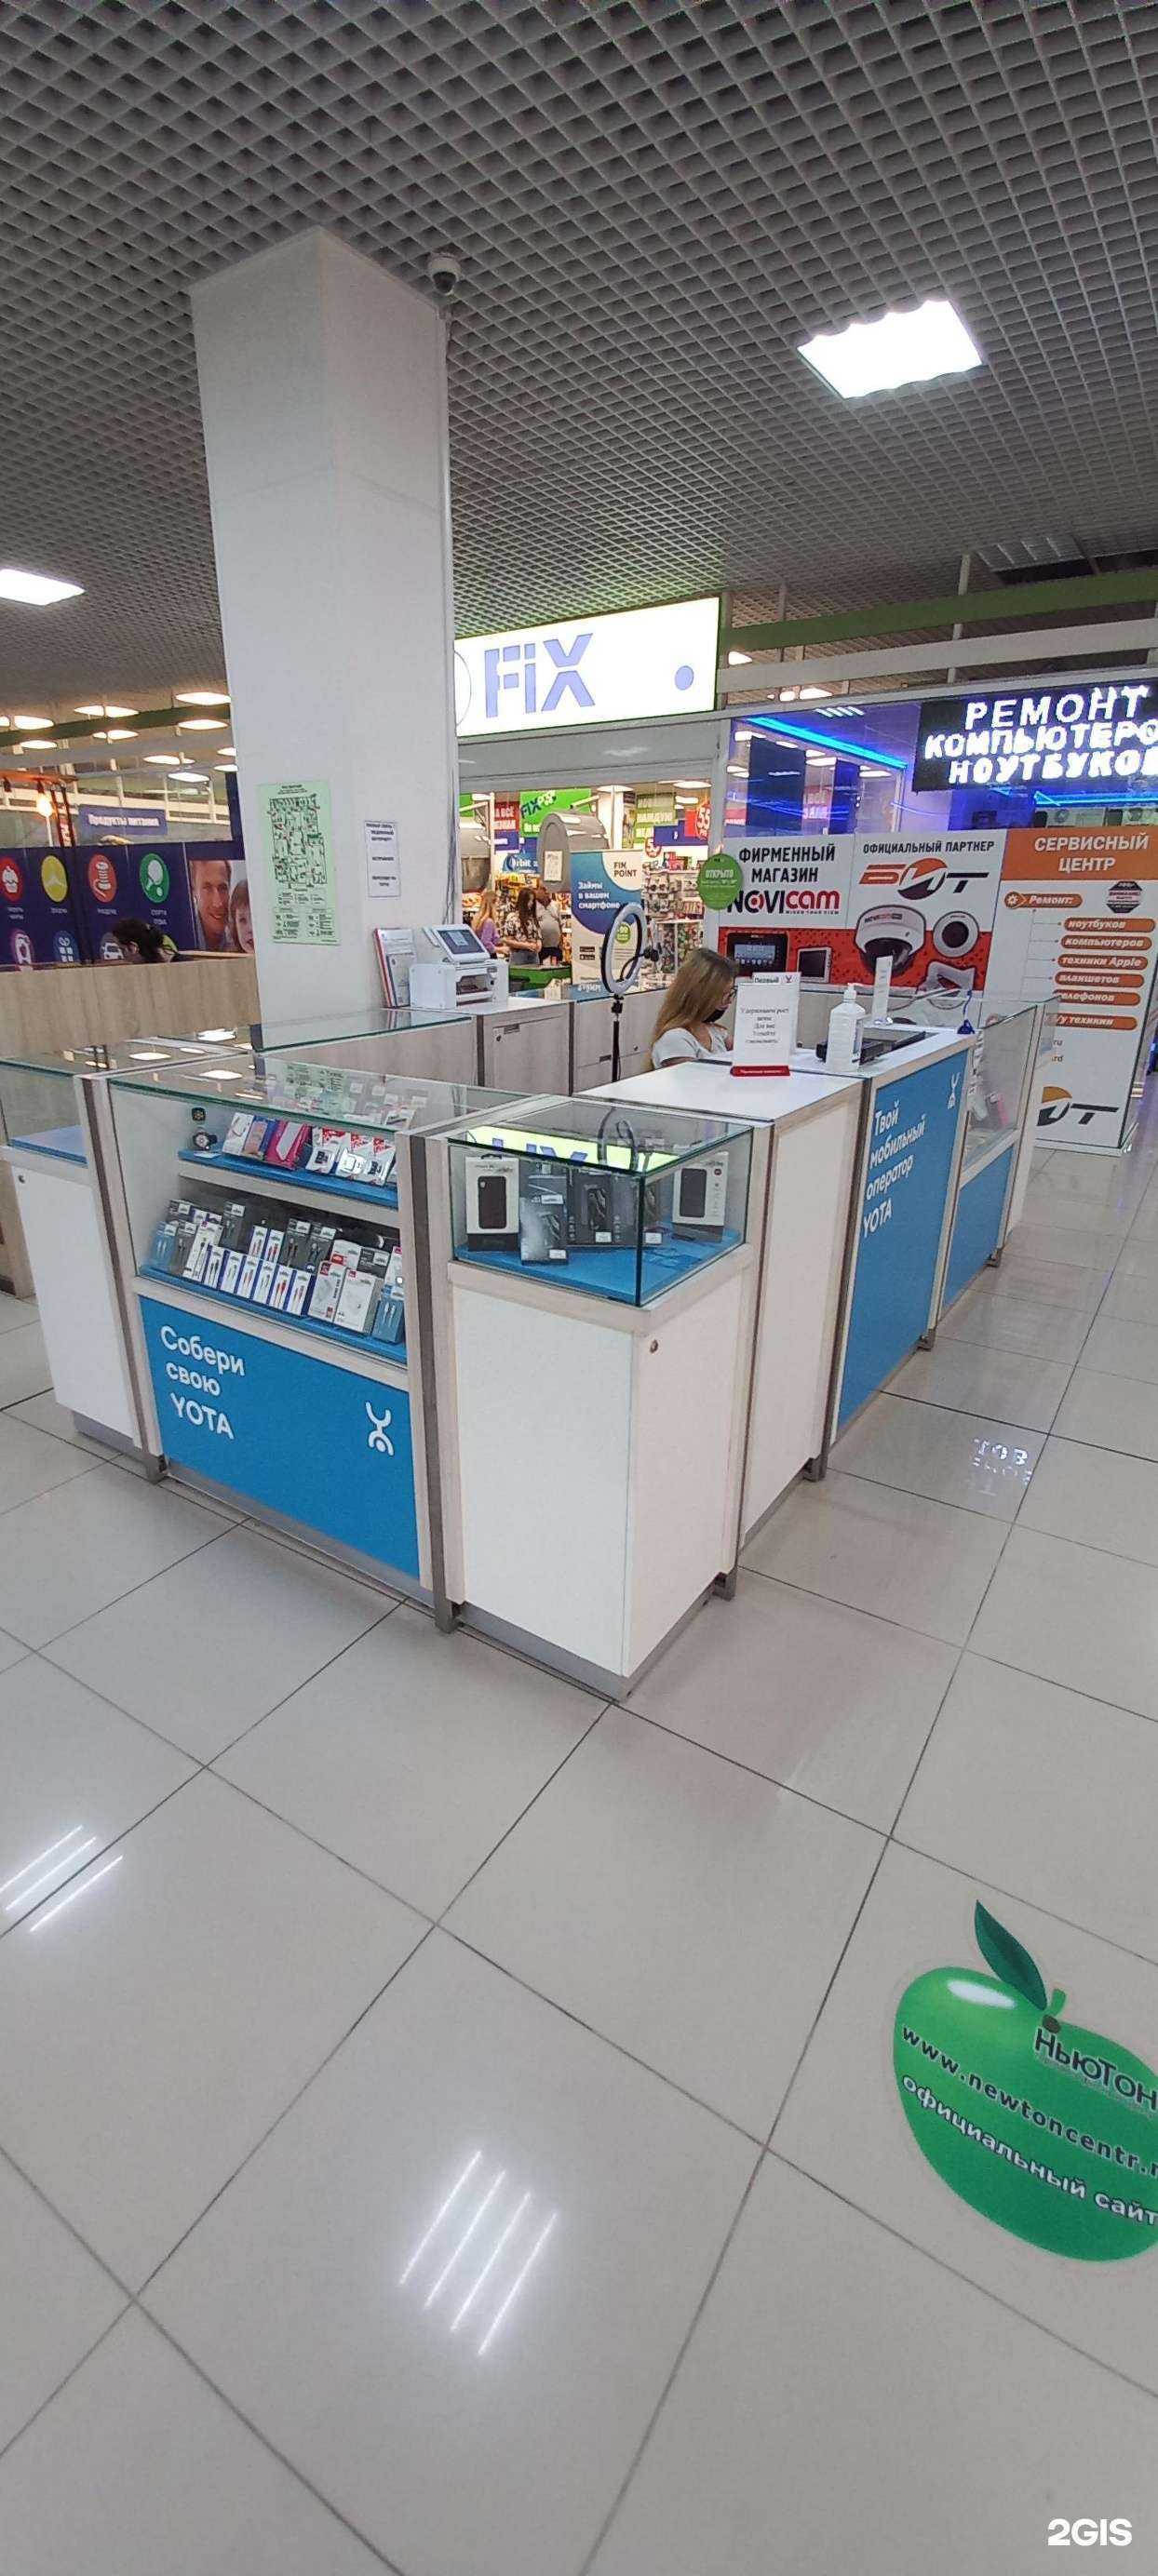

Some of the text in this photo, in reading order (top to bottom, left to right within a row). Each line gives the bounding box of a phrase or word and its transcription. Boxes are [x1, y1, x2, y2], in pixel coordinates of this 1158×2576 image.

[965, 685, 1150, 730] РЕМОНТ
[863, 840, 994, 854] ОФИЦИАЛЬНЫЙ ПАРТНЕР
[1034, 832, 1151, 852] СЕРВИСНЫЙ
[739, 843, 835, 864] ФИРМЕННЫЙ
[613, 870, 638, 879] POINT
[751, 867, 818, 882] МАГАЗИН
[1058, 857, 1116, 874] ЦЕНТР
[578, 881, 603, 891] Займы
[578, 901, 621, 911] смартфоне
[1068, 919, 1126, 930] ноутбуков
[1064, 938, 1144, 948] компьютеров
[1062, 957, 1141, 968] техники Apple
[1069, 1015, 1114, 1026] техники
[874, 1099, 900, 1136] Твой
[869, 1114, 926, 1170] мобильный
[866, 1154, 914, 1201] оператор
[863, 1198, 893, 1239] YOTA
[160, 1325, 245, 1376] Собери
[166, 1362, 222, 1396] свою
[170, 1392, 235, 1440] YOTA
[902, 2075, 1086, 2199] официальный
[1094, 2193, 1158, 2226] сайт
